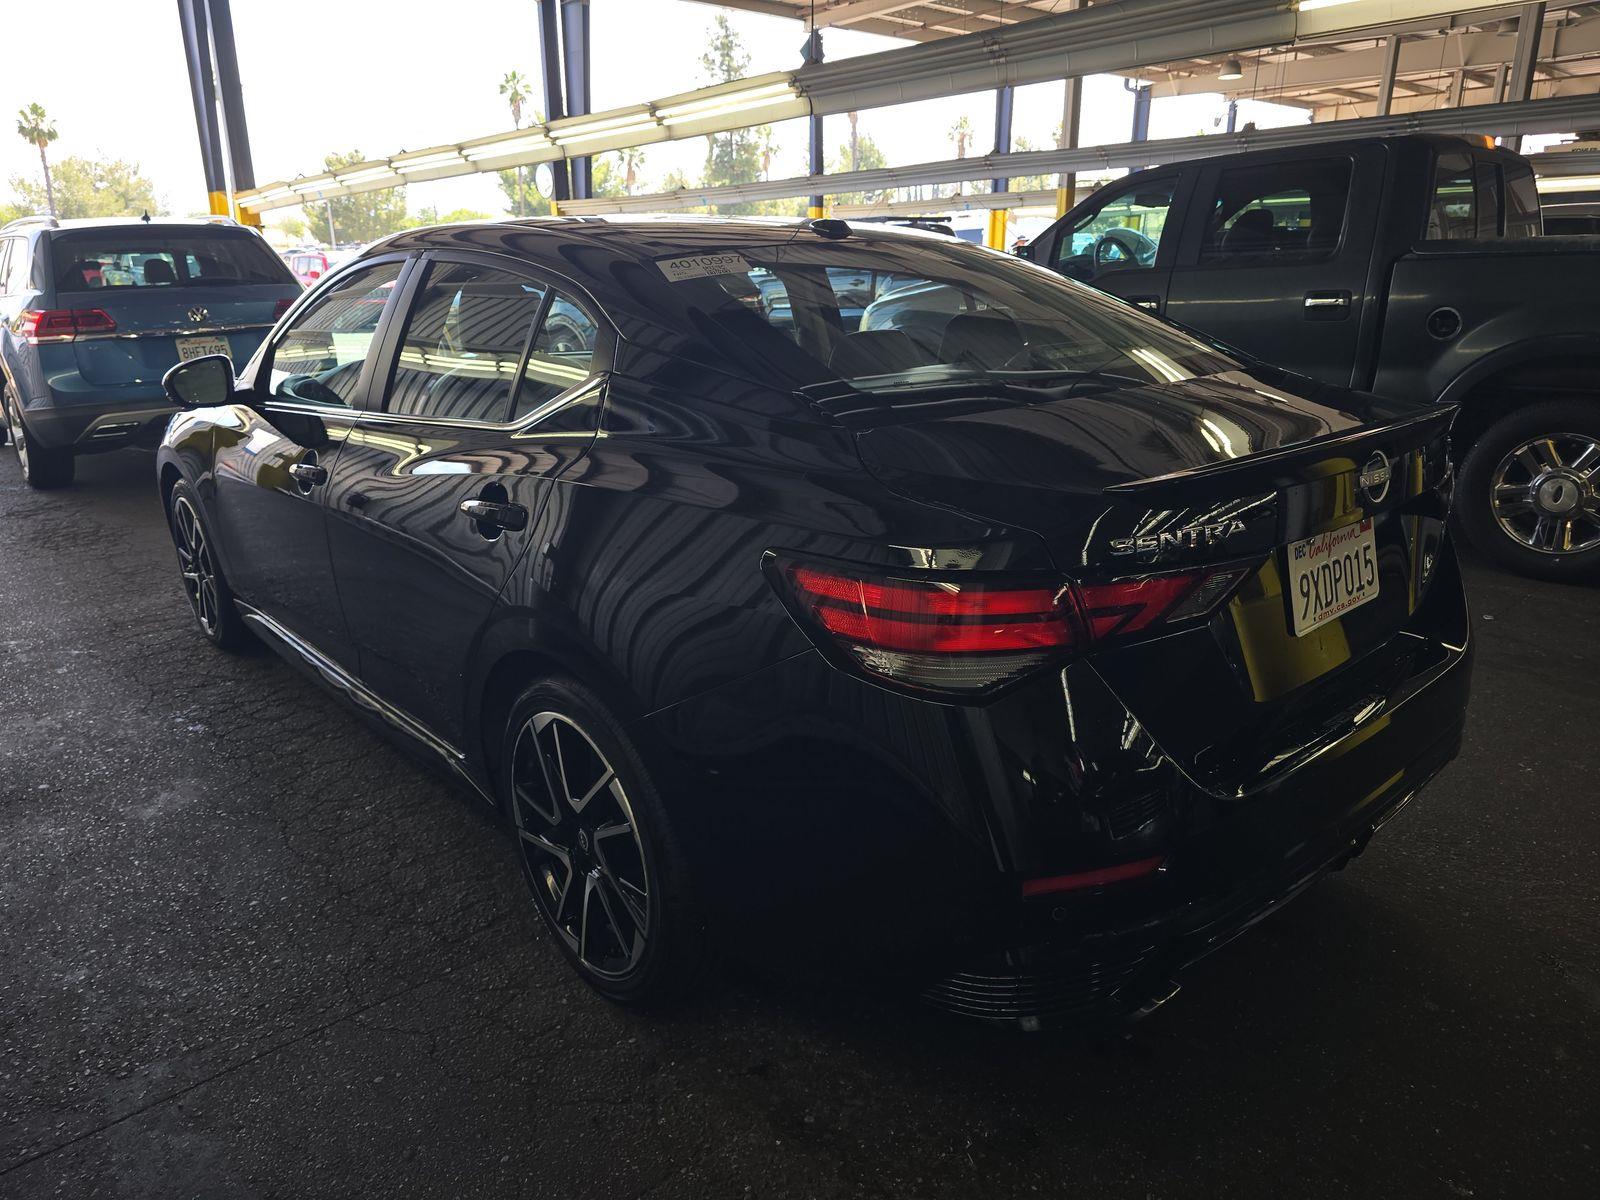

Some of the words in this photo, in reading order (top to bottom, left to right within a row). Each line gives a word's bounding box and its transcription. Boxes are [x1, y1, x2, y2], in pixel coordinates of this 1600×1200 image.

[670, 256, 742, 269] 4010997
[1110, 519, 1247, 556] SENTRA
[1294, 543, 1306, 560] DEC
[1309, 528, 1361, 559] California
[1299, 544, 1374, 620] 9XDP015
[1318, 595, 1361, 620] dmv.ca.gov
